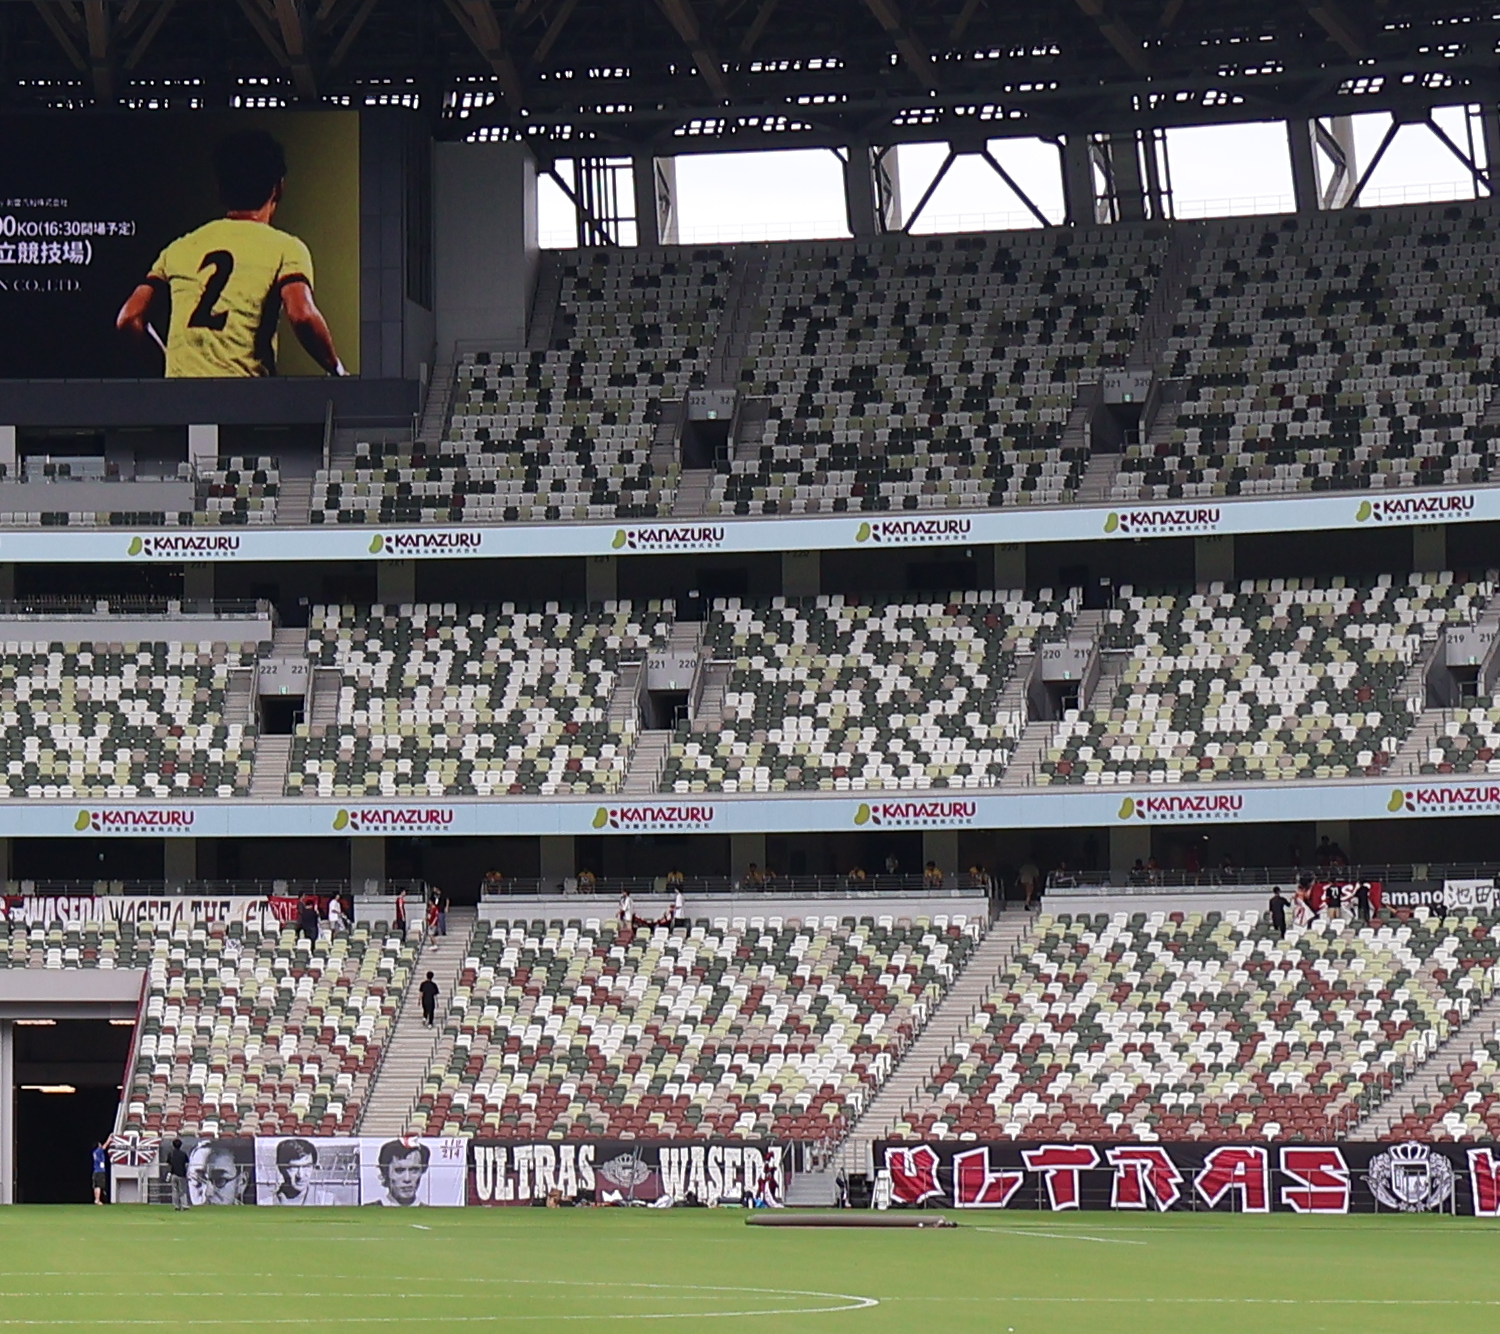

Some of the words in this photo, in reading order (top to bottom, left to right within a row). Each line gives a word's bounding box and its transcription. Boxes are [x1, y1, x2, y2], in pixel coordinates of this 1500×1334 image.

[188, 249, 234, 331] 2
[1383, 494, 1474, 512] KANAZURU
[1129, 509, 1220, 527] KANAZURU
[637, 527, 724, 544] KANAZURU
[882, 520, 971, 537] KANAZURU
[153, 535, 239, 550] KANAZURU
[394, 533, 481, 550] KANAZURU
[1447, 634, 1465, 644] 219
[1043, 649, 1061, 659] 220
[1074, 649, 1091, 659] 219
[260, 665, 278, 675] 222
[292, 665, 308, 675] 221
[648, 659, 666, 669] 221
[678, 659, 696, 669] 220
[883, 802, 976, 818] KANAZURU
[1147, 795, 1242, 812] KANAZURU
[102, 811, 194, 826] KANAZURU
[361, 810, 453, 825] KANAZURU
[621, 807, 713, 822] KANAZURU
[474, 1145, 596, 1201] ULTRAS
[883, 1144, 1350, 1214] ULTRAS
